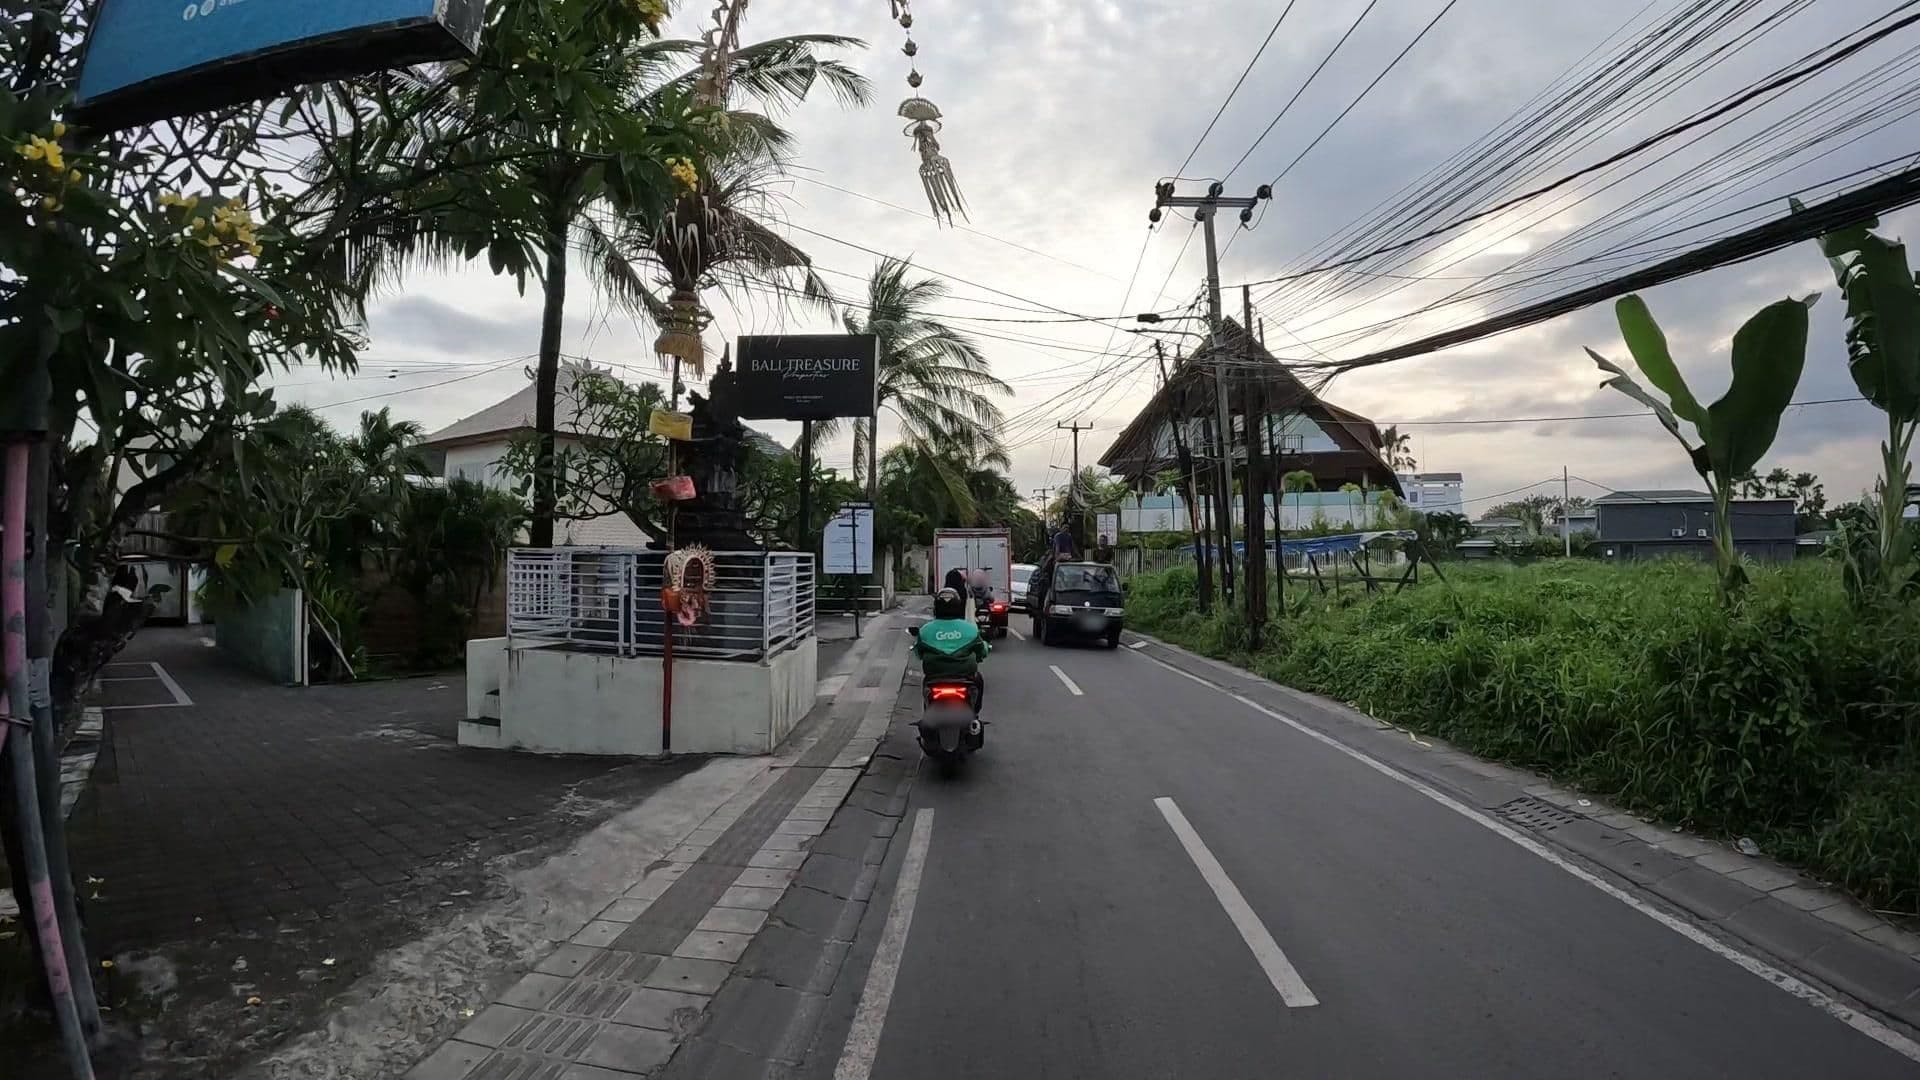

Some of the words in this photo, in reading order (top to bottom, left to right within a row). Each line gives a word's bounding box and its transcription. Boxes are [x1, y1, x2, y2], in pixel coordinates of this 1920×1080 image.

[751, 359, 782, 371] BALI
[785, 358, 861, 371] TREASURE
[935, 629, 962, 641] Grab
